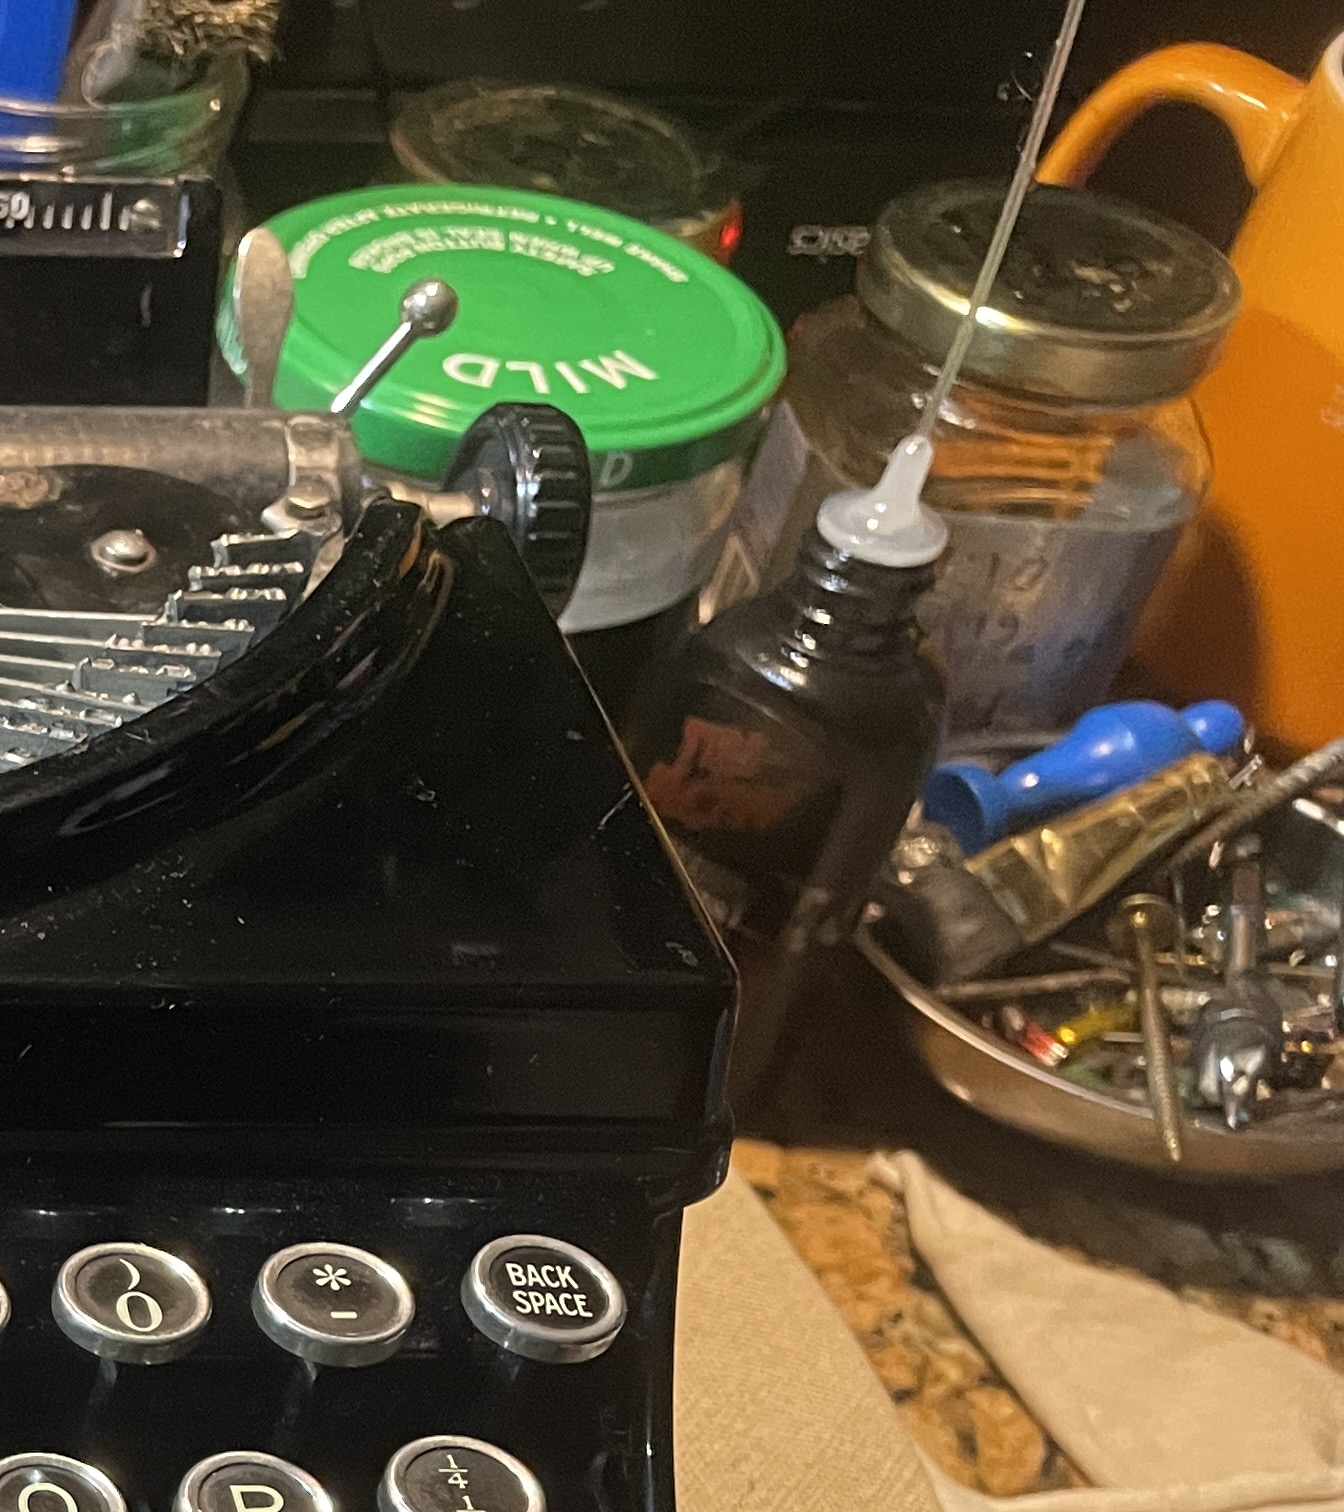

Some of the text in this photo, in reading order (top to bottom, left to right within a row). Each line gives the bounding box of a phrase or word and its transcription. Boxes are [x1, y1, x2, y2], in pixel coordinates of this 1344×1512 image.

[442, 350, 658, 394] MILD
[506, 1263, 578, 1289] BACK
[116, 1292, 162, 1332] 0
[512, 1286, 595, 1320] SPACE
